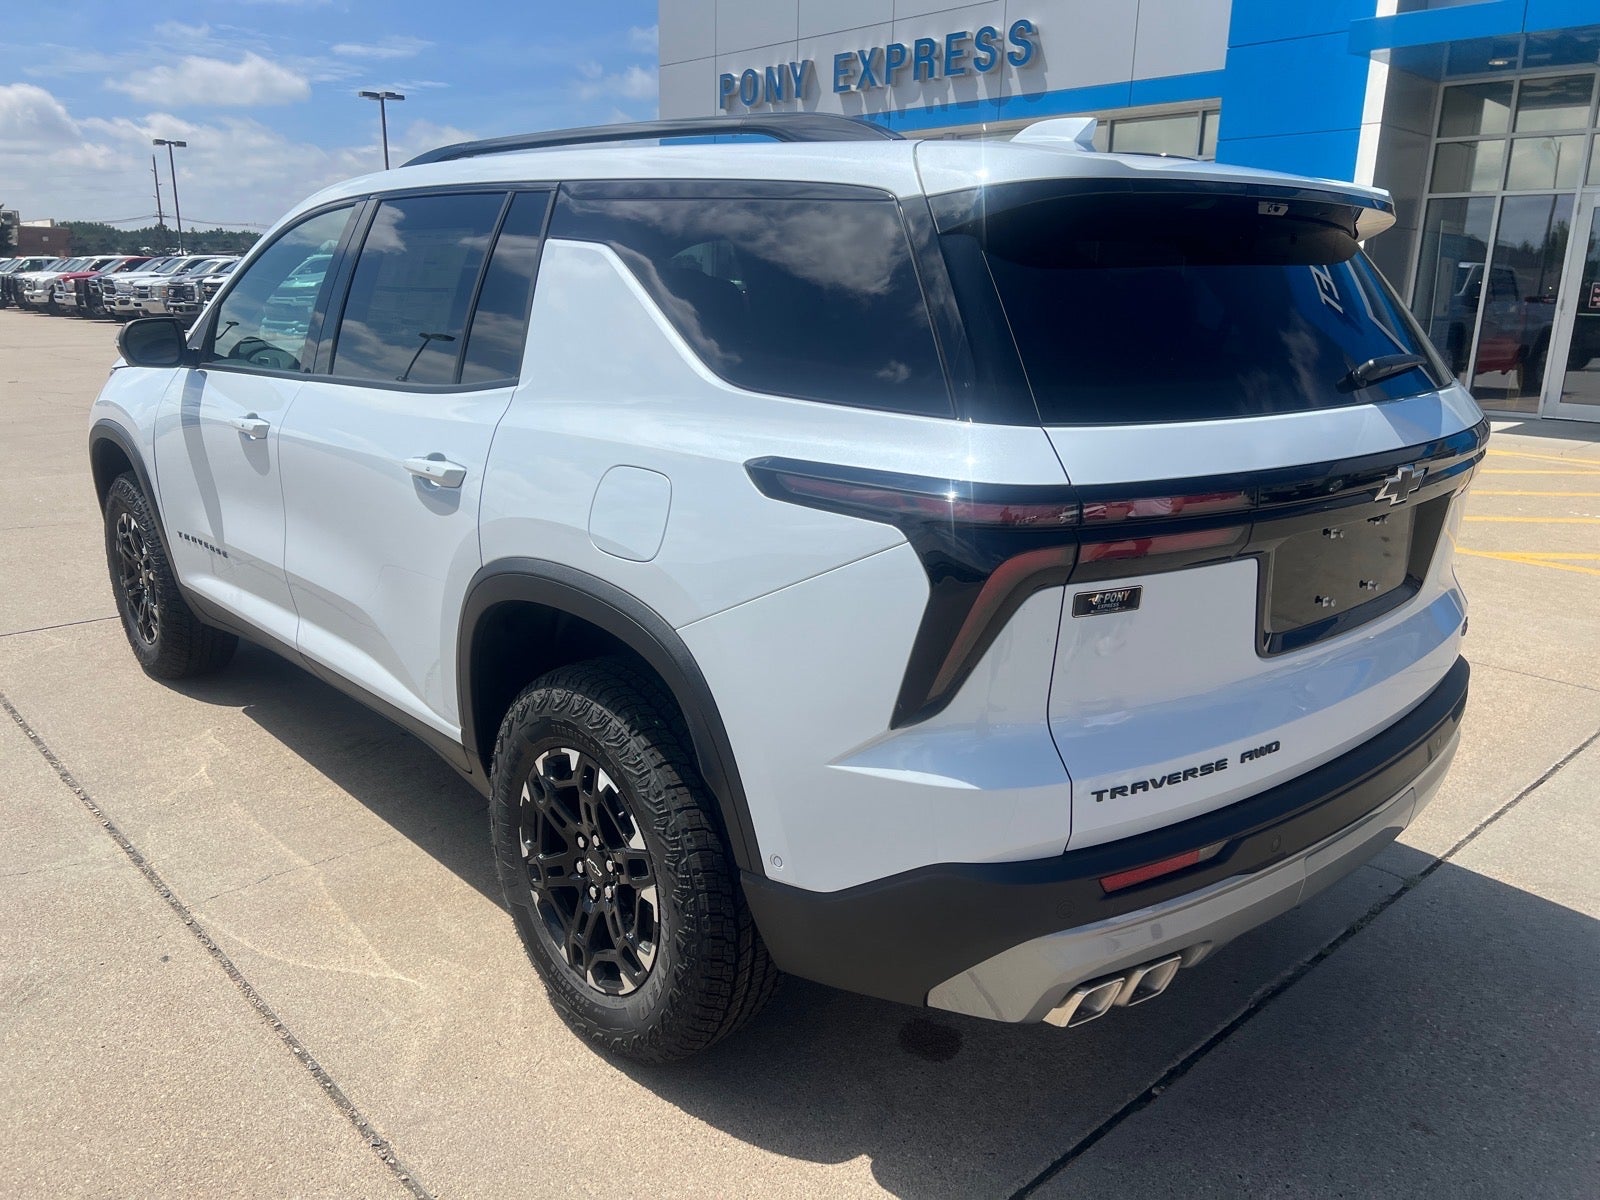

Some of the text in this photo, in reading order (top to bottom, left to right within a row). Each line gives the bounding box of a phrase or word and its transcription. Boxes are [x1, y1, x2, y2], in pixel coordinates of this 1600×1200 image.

[719, 19, 1036, 110] PONY EXPRESS
[177, 530, 229, 559] TRAVERSE
[1097, 602, 1120, 610] EXPRESS
[1104, 590, 1131, 603] PONY
[1091, 740, 1281, 802] TRAVERSE AWD
